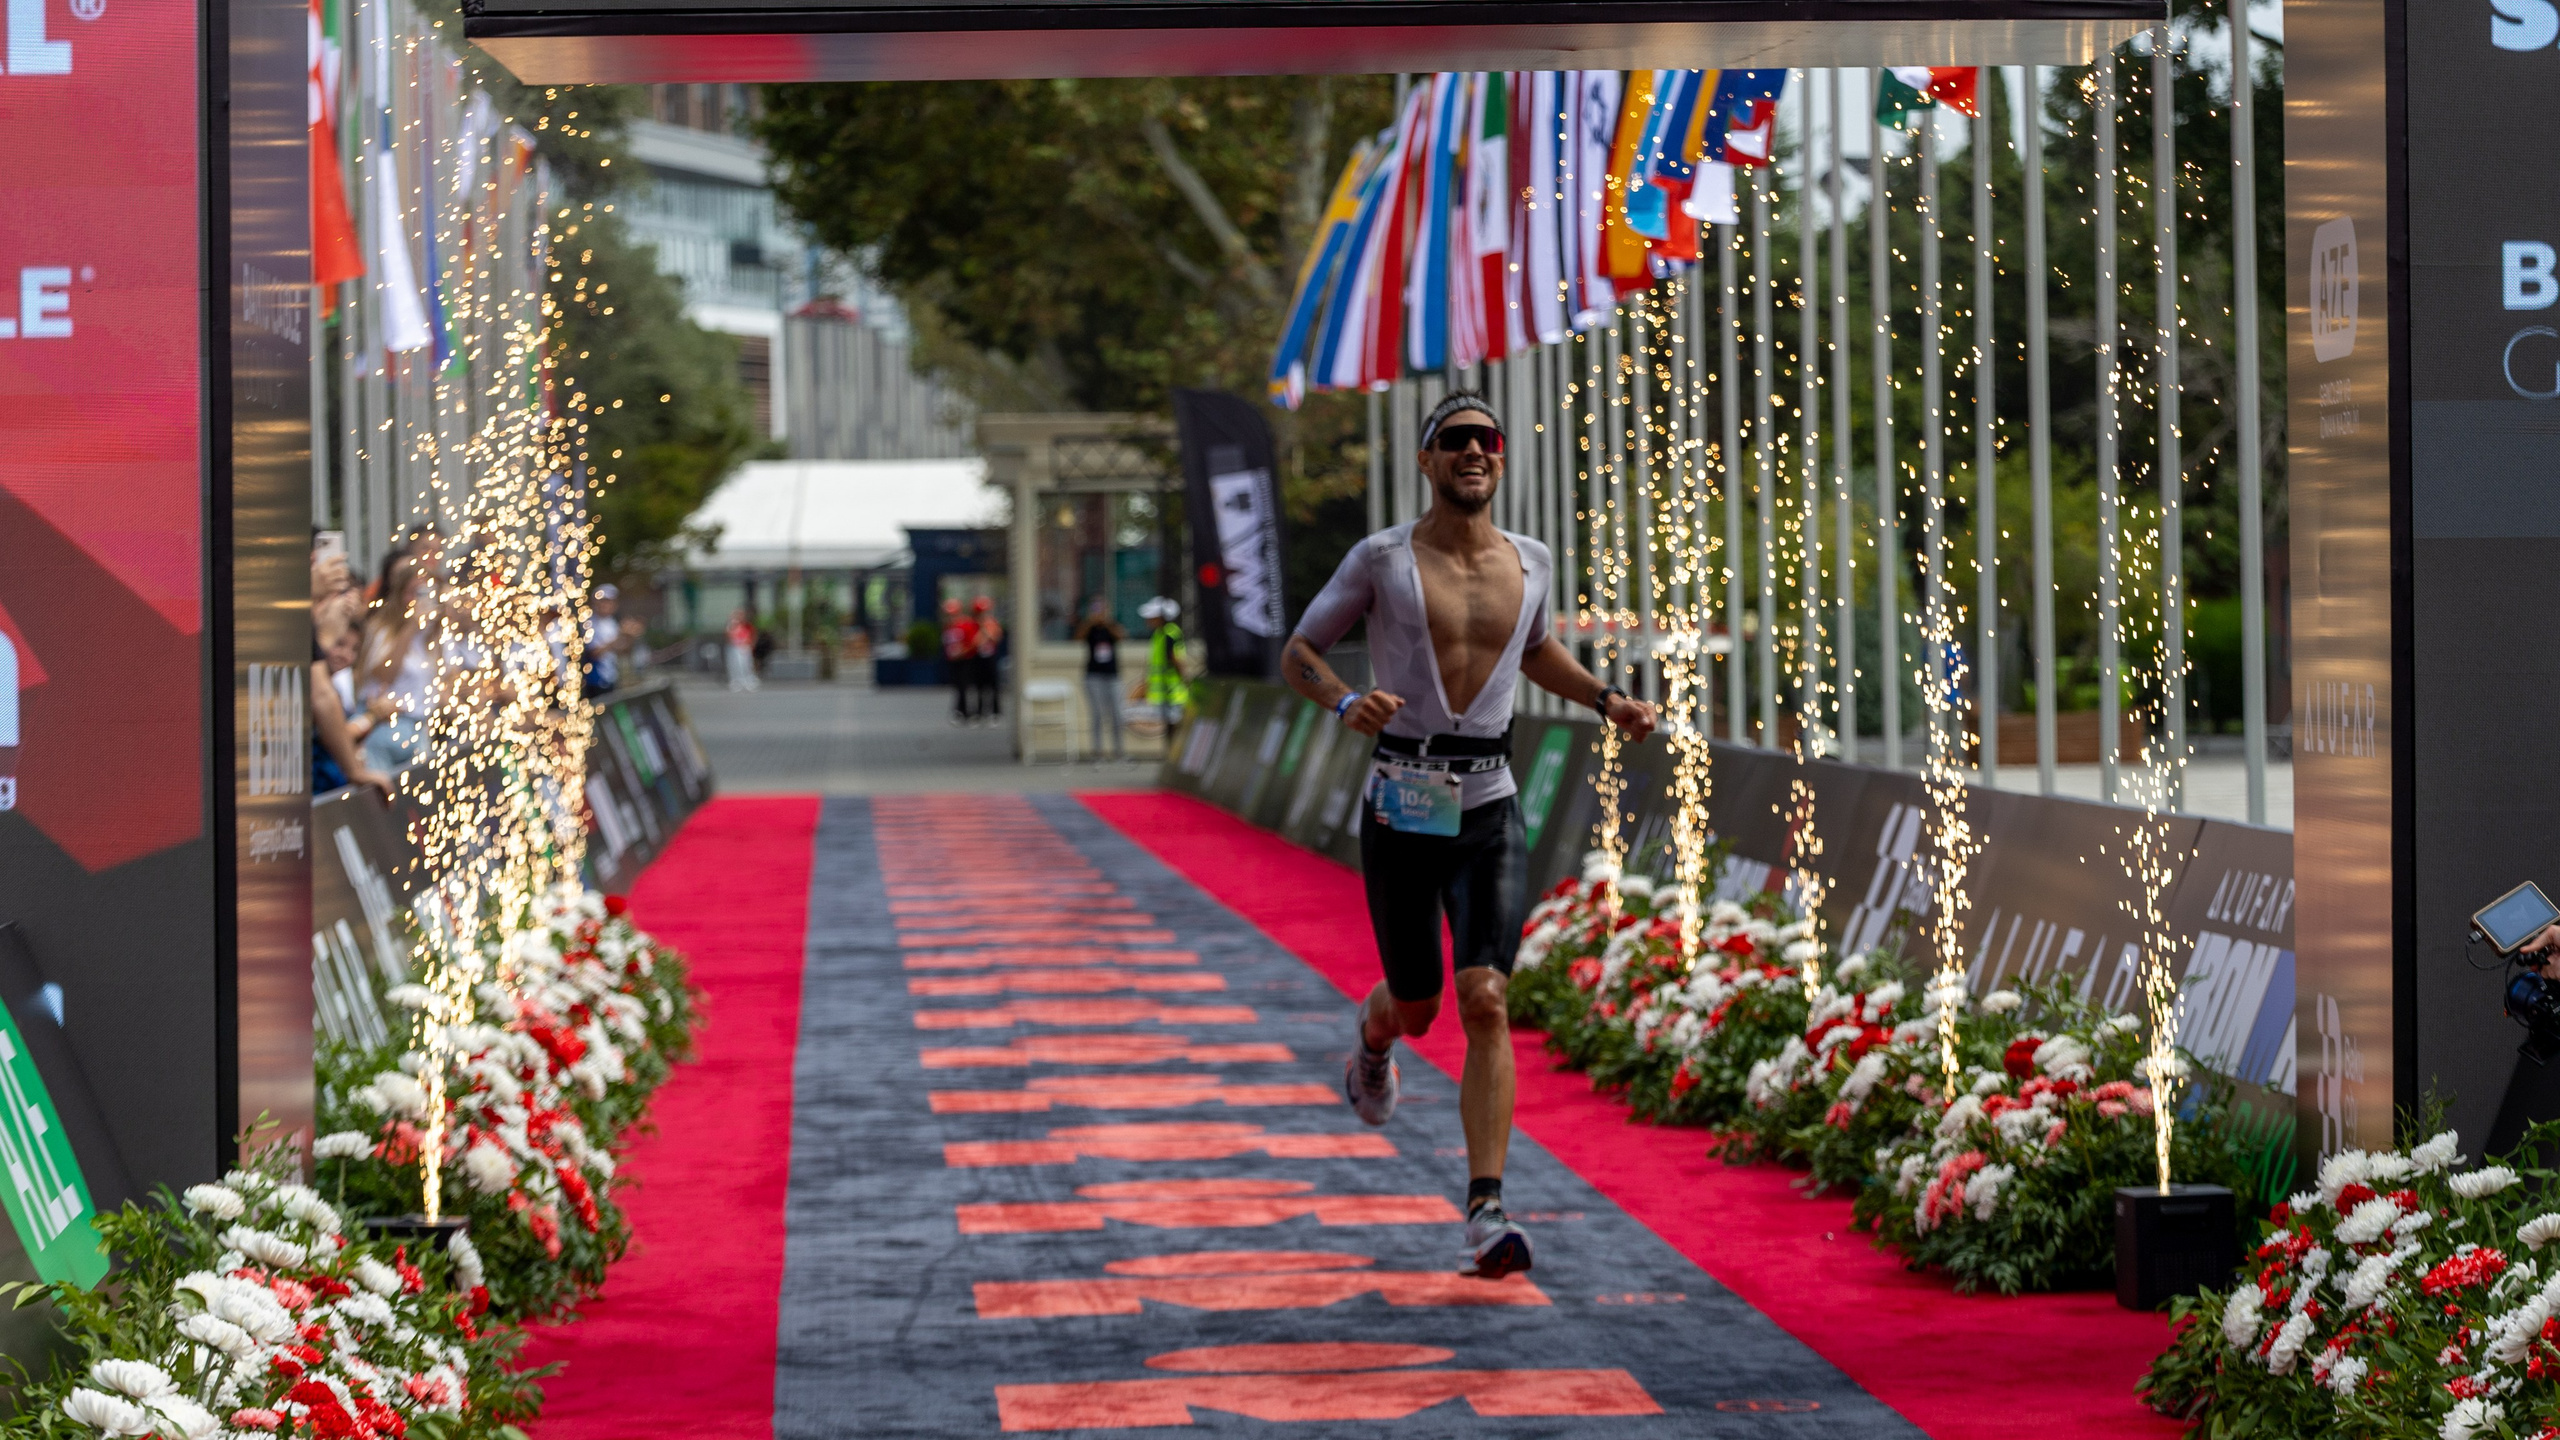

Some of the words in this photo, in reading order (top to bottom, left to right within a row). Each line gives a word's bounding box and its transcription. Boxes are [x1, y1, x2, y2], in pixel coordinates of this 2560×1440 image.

[2319, 242, 2350, 337] AZE
[2303, 680, 2376, 760] ALUFAR
[1397, 787, 1434, 808] 104
[2206, 867, 2296, 934] ALUFAR
